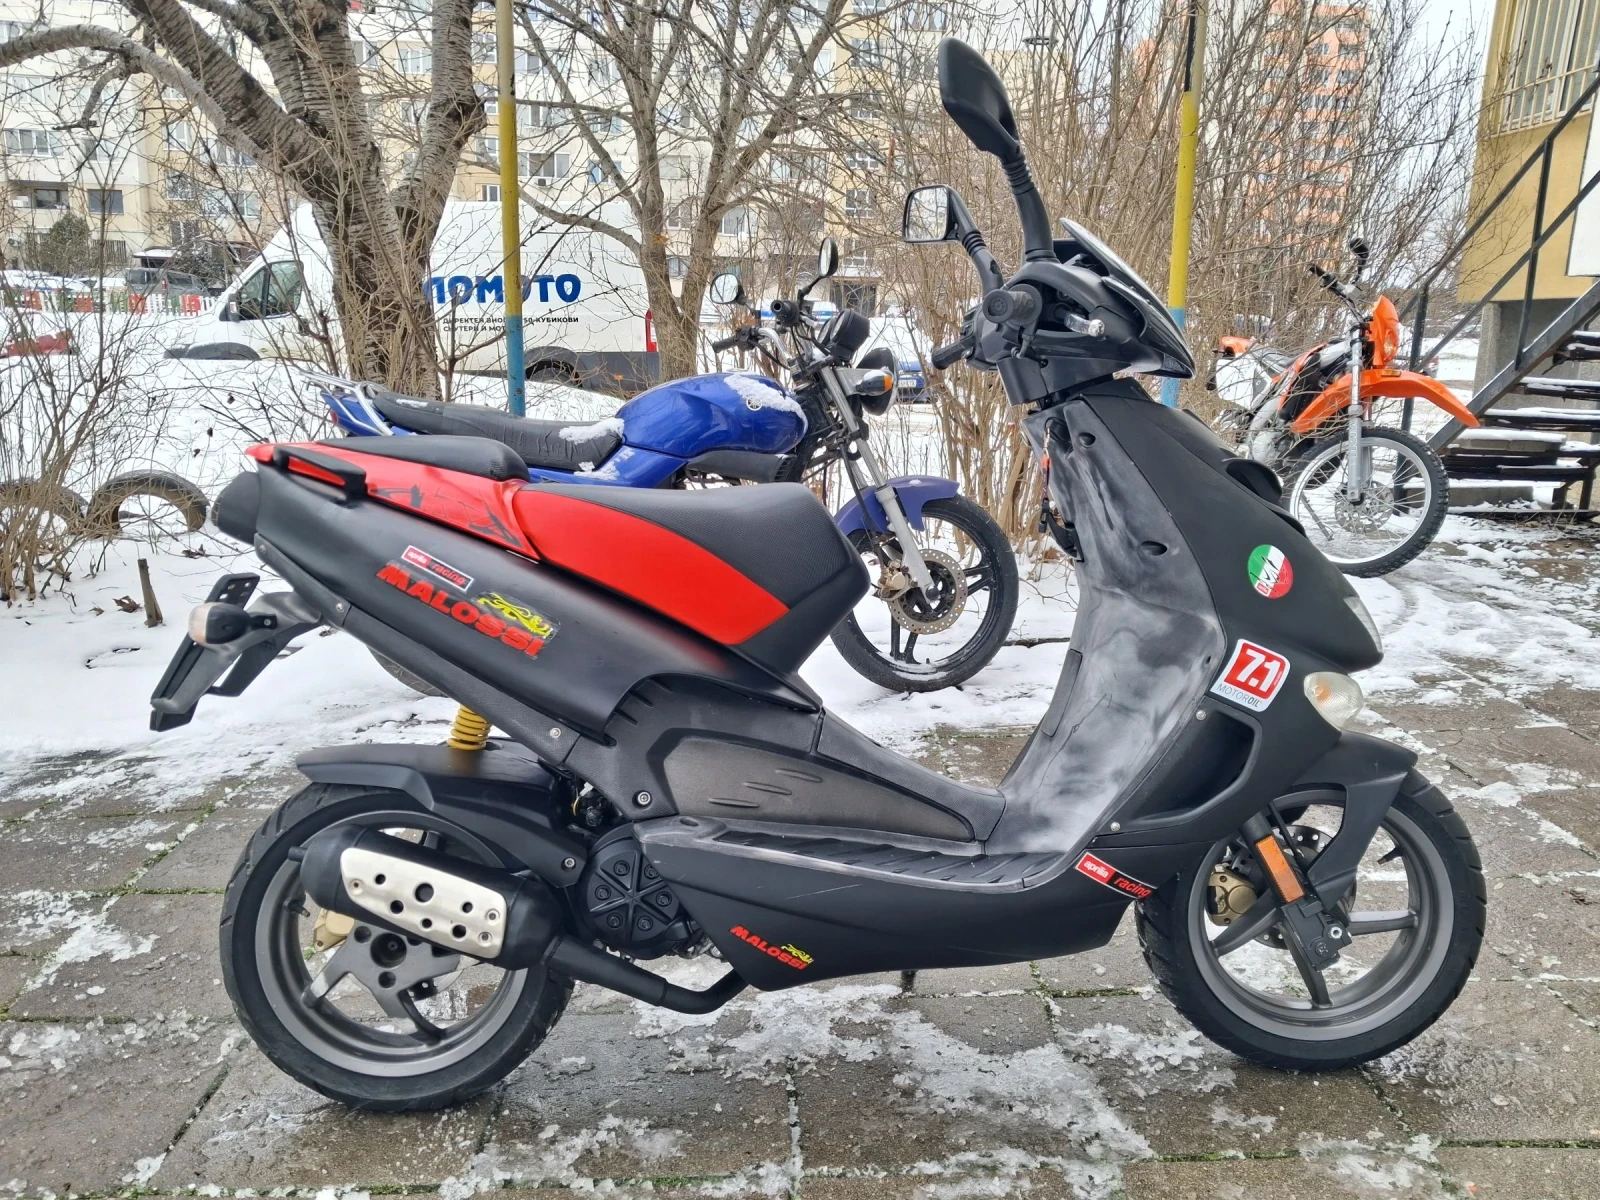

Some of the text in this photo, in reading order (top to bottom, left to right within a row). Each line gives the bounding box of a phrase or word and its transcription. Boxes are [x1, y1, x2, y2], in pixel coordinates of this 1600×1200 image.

[431, 563, 466, 586] racing
[376, 564, 545, 657] MALOSSI
[1236, 648, 1281, 693] 7.1
[1217, 683, 1260, 708] MOTOROIL
[1114, 877, 1153, 900] racing
[729, 925, 808, 971] MALOSSI
